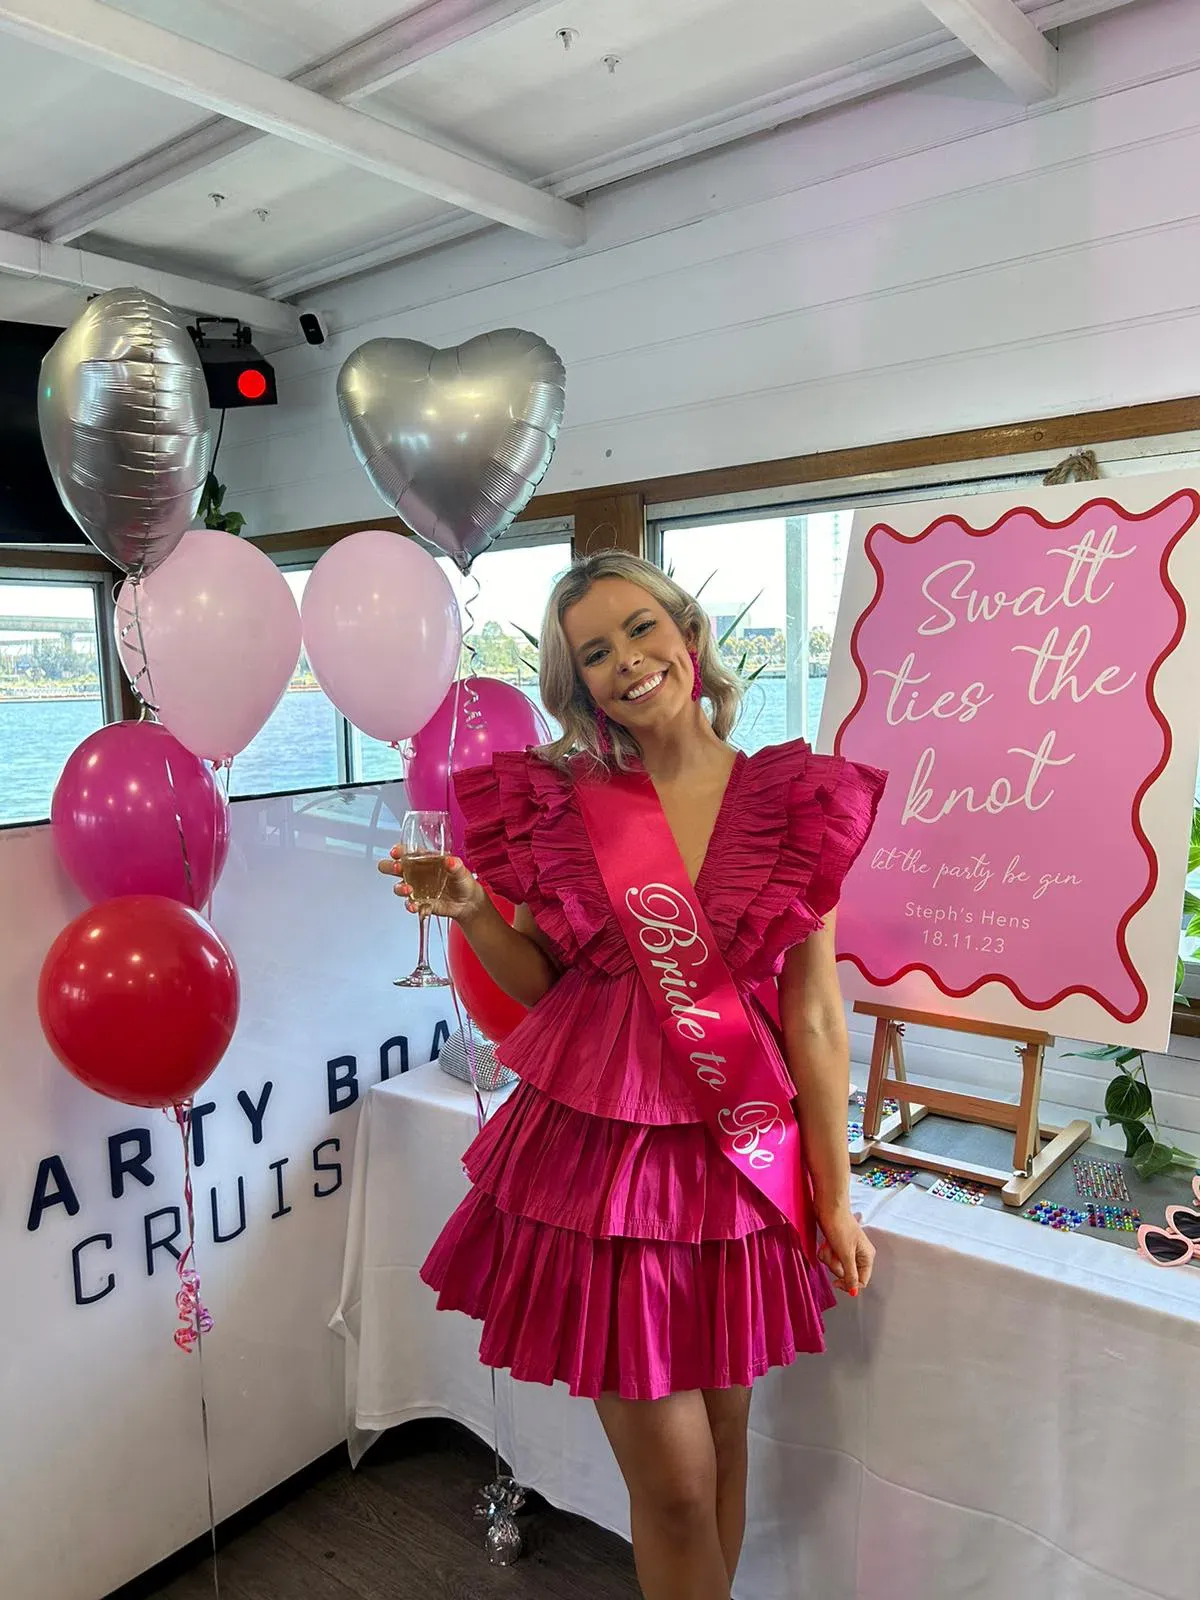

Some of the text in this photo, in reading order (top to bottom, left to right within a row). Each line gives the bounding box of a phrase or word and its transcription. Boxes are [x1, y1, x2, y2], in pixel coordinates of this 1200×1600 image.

[917, 525, 1137, 637] Swatt
[872, 624, 1137, 726] ties the
[901, 730, 1076, 826] knot
[870, 847, 1082, 900] let the party be gin
[904, 901, 1031, 930] Steph's Hens
[922, 930, 1005, 954] 18.11.23
[625, 882, 786, 1170] Bride to Be
